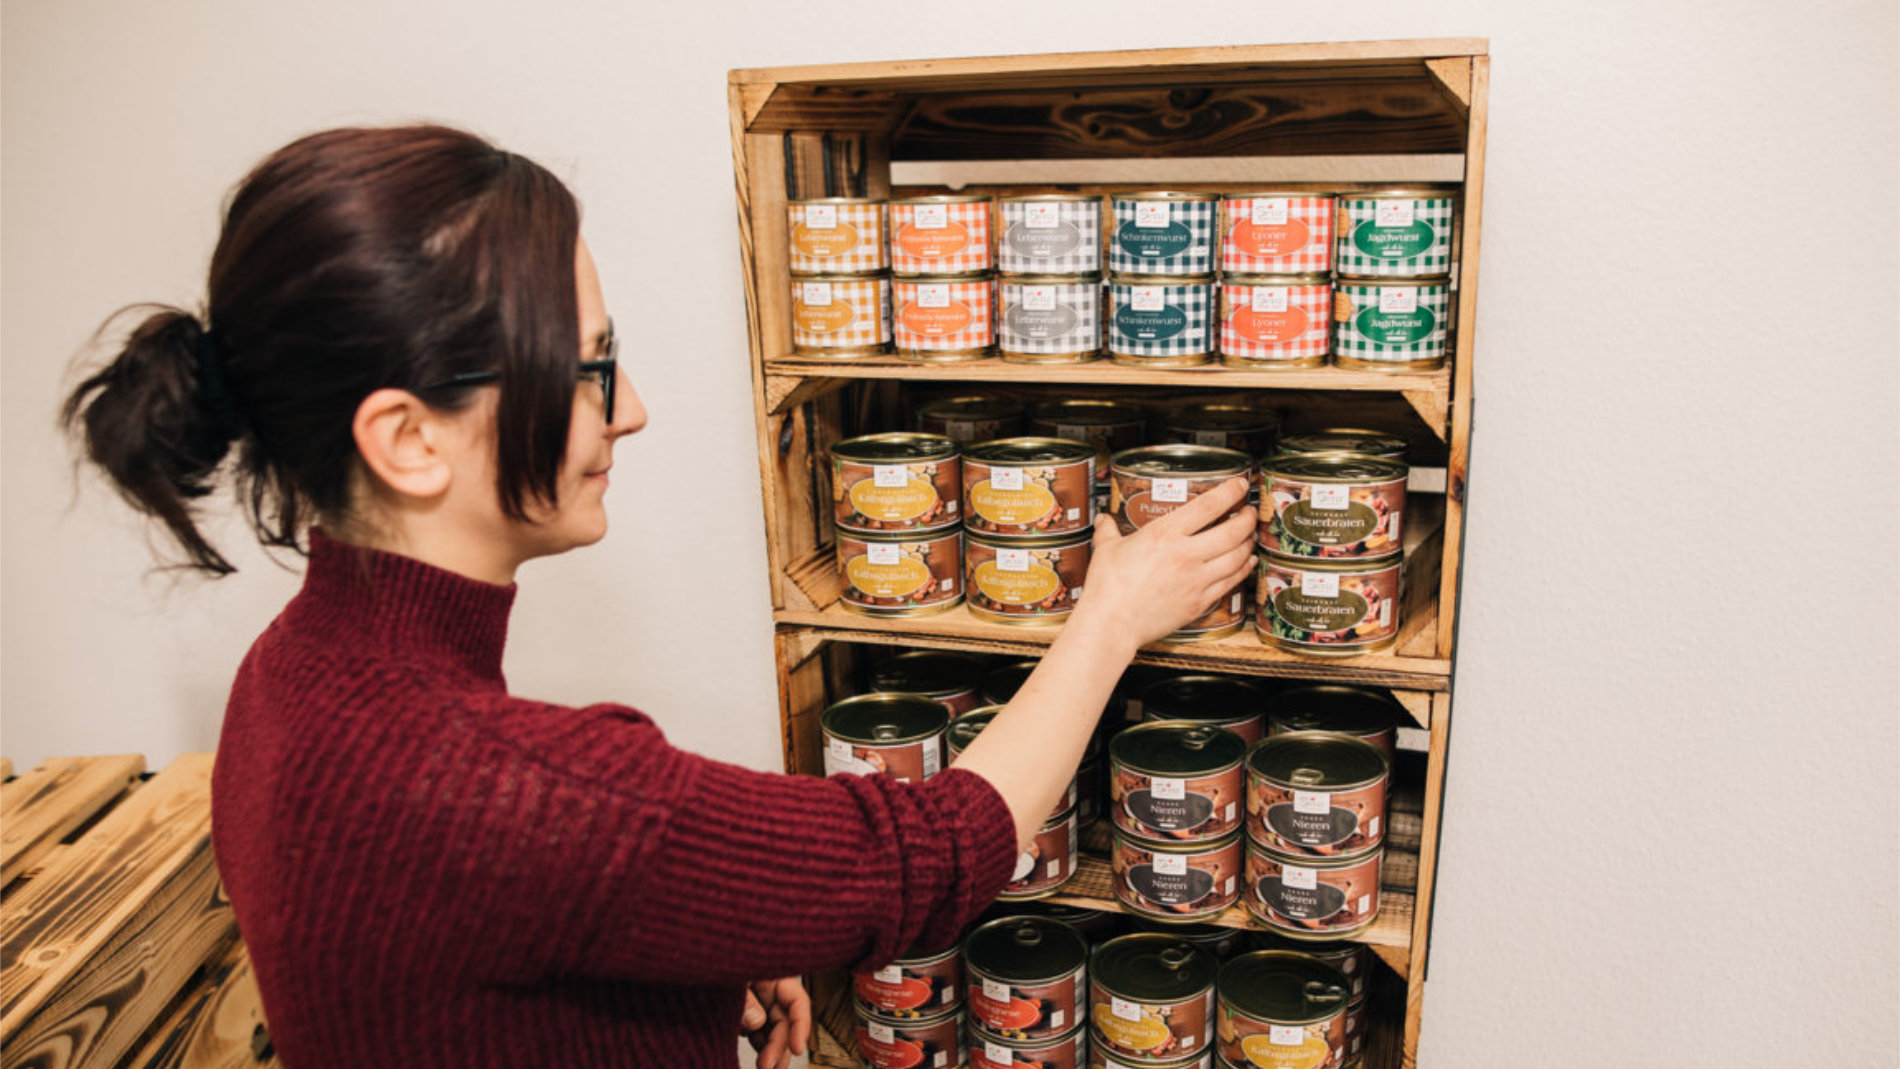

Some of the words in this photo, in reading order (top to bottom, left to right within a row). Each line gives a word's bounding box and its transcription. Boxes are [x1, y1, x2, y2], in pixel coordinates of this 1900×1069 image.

[1016, 233, 1068, 243] Leberwurst
[1121, 232, 1187, 243] Schinkenwurst
[1252, 231, 1288, 243] Lyoner
[1367, 232, 1420, 243] Jagdwurst
[1118, 316, 1183, 326] Schinkenwurst
[1252, 318, 1288, 328] Lyoner
[1371, 318, 1422, 329] Jagdwurst
[1293, 515, 1365, 528] Sauerbraten
[1285, 601, 1356, 615] Sauerbraten
[1150, 804, 1186, 816] Nieren
[1292, 818, 1330, 831] Nieren
[1152, 878, 1187, 890] Nieren
[1280, 893, 1317, 905] Nieren
